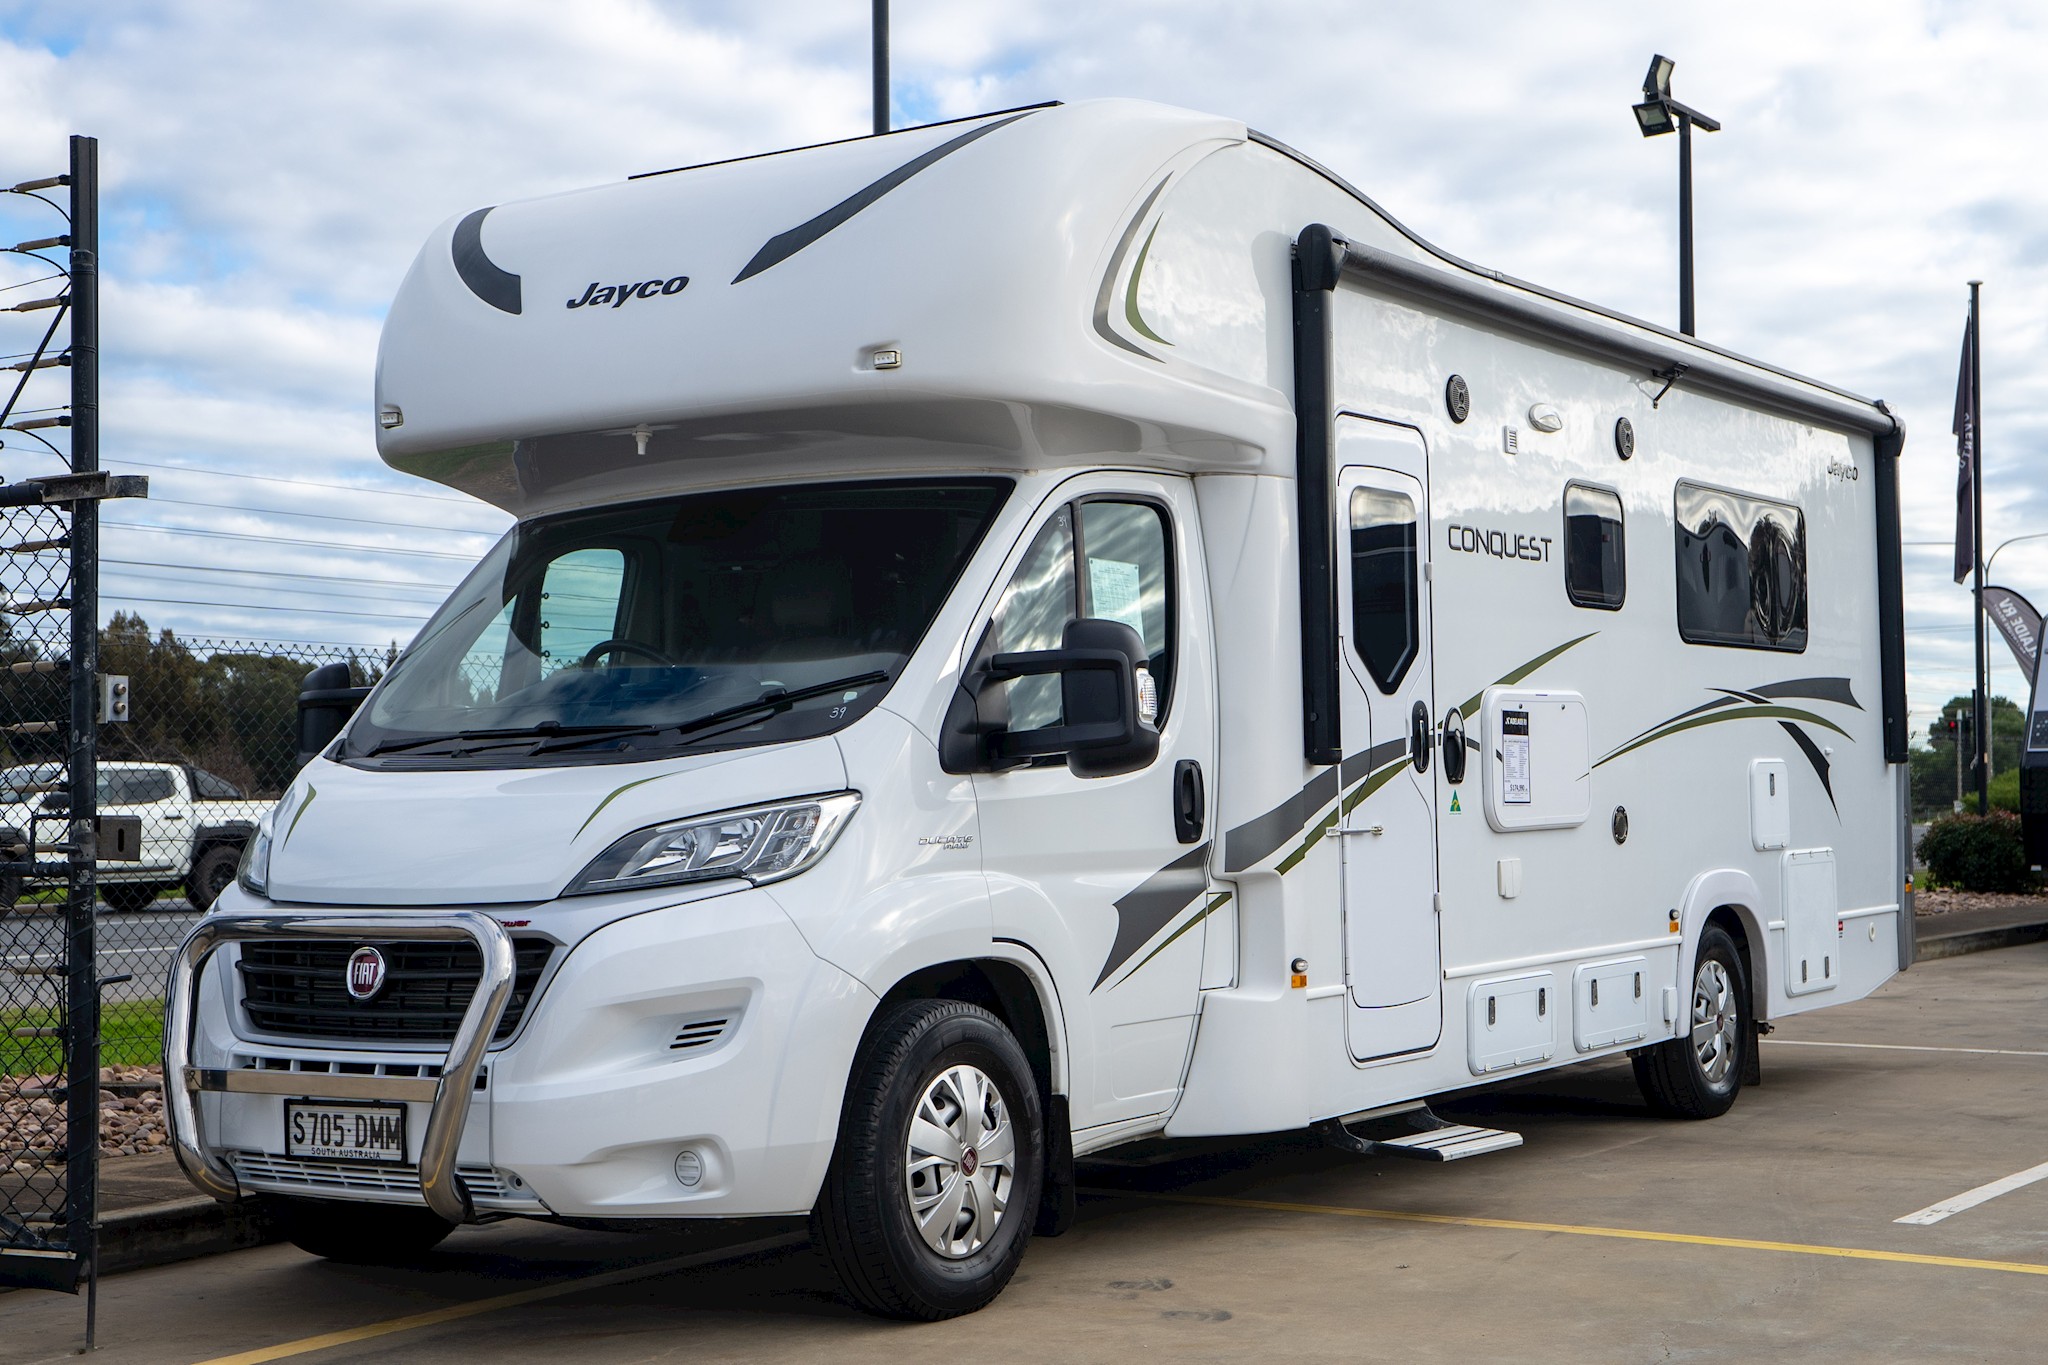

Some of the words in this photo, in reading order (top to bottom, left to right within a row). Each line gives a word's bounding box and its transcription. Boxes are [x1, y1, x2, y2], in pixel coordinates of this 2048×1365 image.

[566, 276, 690, 309] Jayco
[1827, 456, 1859, 482] Jayco
[1448, 523, 1552, 562] CONQUEST
[829, 706, 847, 719] 39
[353, 962, 377, 985] FIAT
[311, 1147, 336, 1155] SOUTH
[339, 1150, 380, 1159] AUSTRALIA
